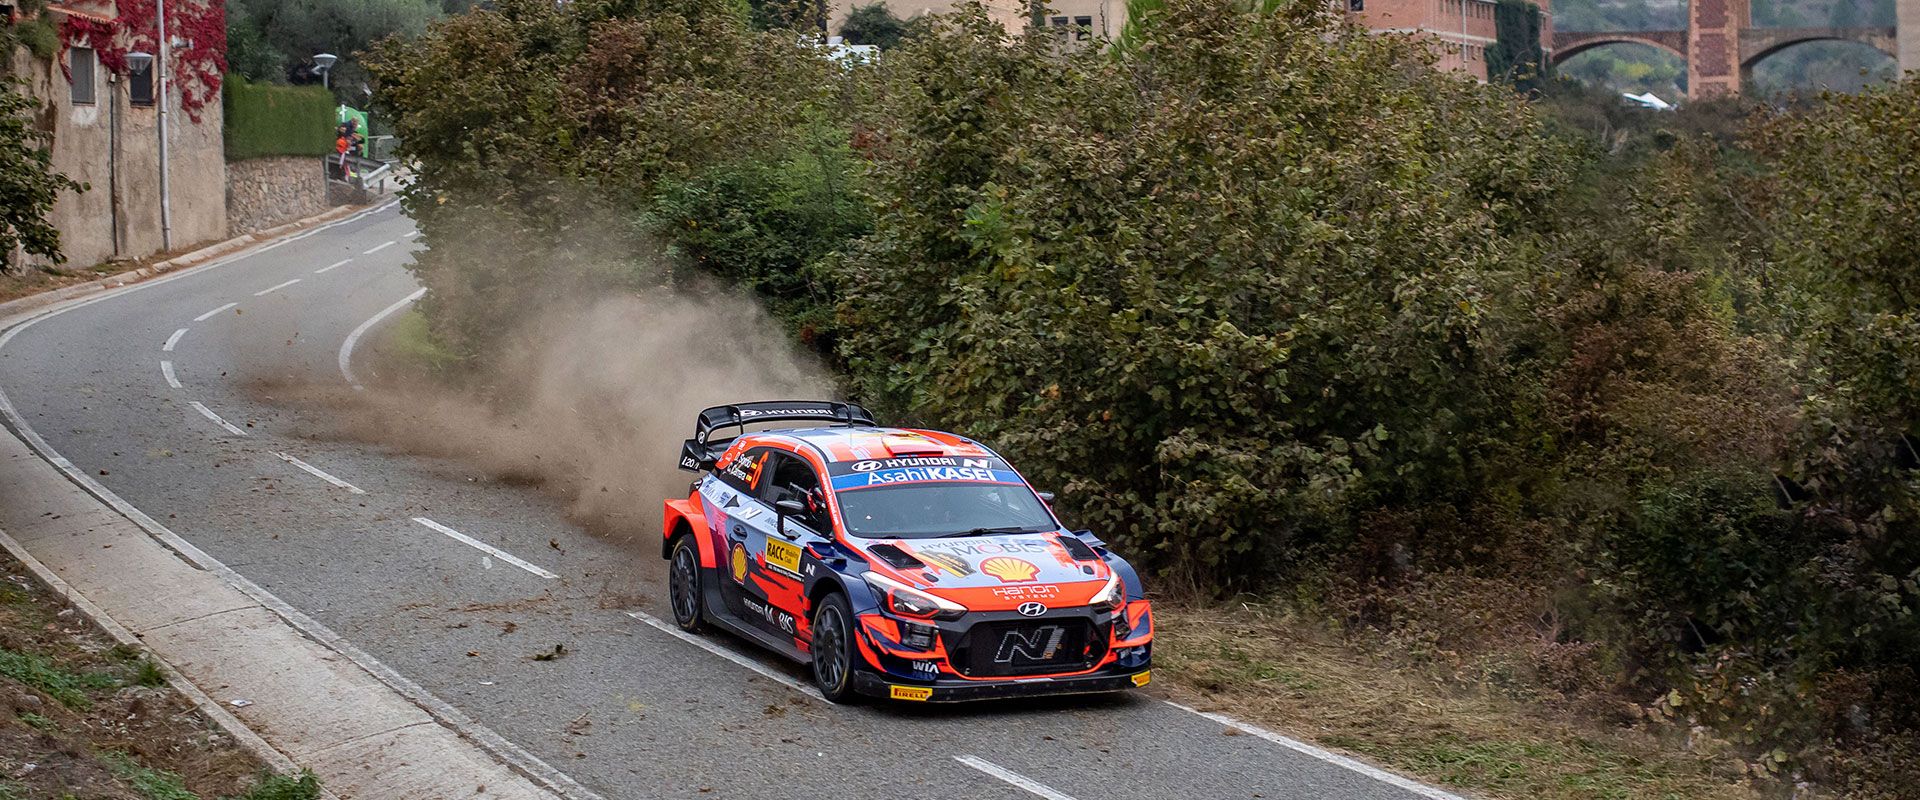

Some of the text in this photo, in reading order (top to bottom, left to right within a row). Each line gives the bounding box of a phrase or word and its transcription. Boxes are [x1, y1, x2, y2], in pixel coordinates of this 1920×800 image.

[885, 457, 958, 468] HYUNDAI
[750, 450, 769, 490] 6
[767, 542, 785, 561] RACC
[921, 539, 992, 550] HYUNDAI
[950, 543, 1046, 556] MOBIS
[805, 562, 816, 577] N
